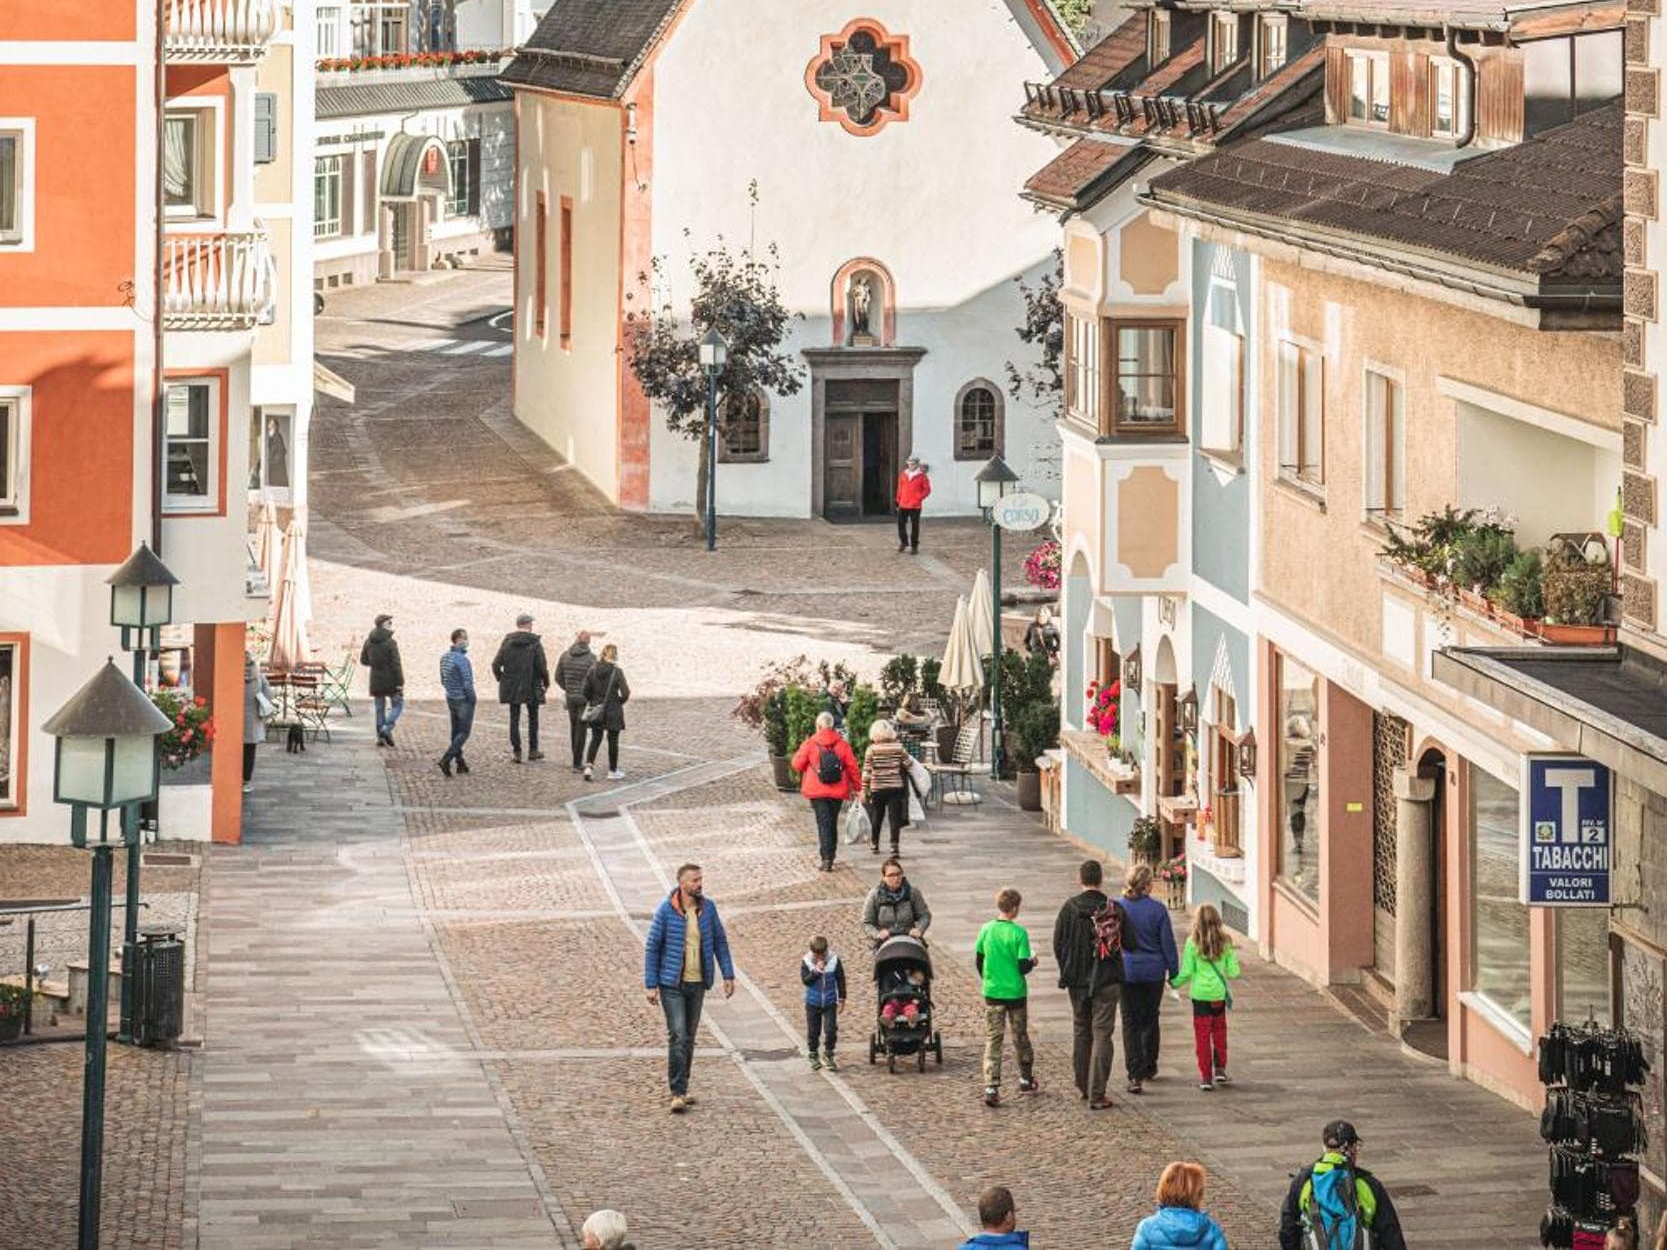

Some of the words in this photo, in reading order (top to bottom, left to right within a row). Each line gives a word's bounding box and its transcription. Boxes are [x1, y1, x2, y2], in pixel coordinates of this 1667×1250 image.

[1545, 769, 1596, 843] T
[1588, 829, 1599, 841] 2
[1533, 846, 1608, 870] TABACCHI
[1549, 877, 1593, 888] VALORI
[1546, 890, 1596, 900] BOLLATI
